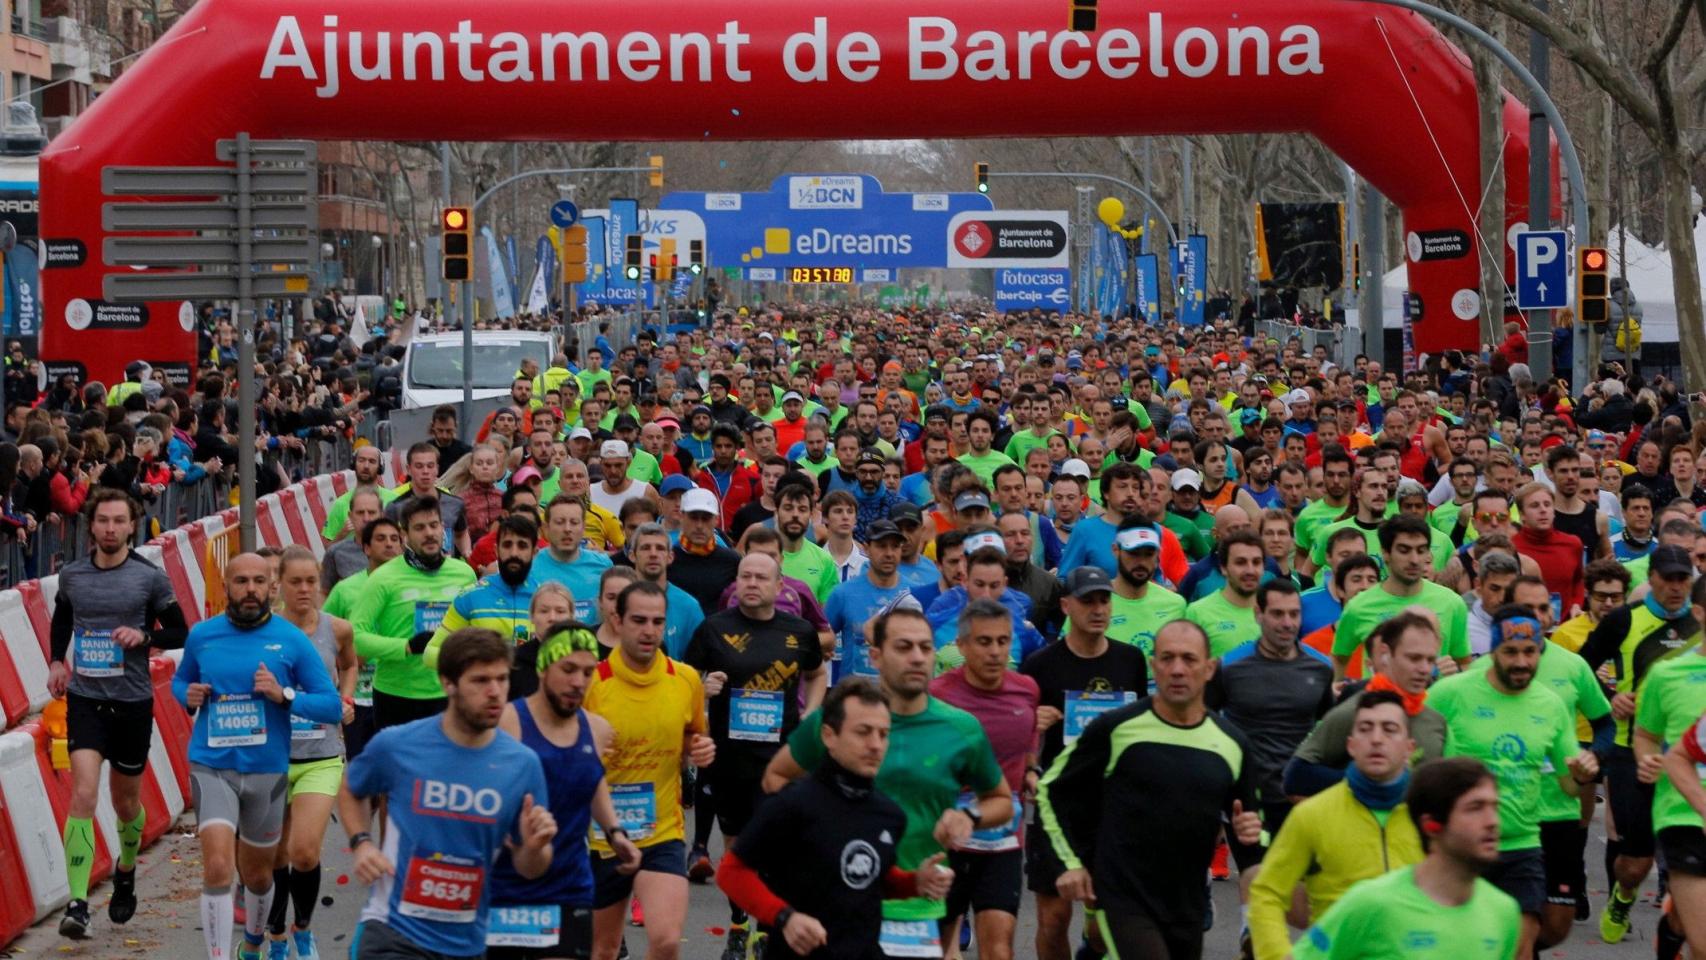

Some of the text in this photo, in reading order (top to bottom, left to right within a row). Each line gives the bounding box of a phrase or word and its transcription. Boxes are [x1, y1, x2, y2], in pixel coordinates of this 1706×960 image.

[259, 12, 1324, 98] Ajuntament de Barcelona
[821, 177, 855, 186] eDreams
[999, 229, 1053, 238] Ajuntament de
[796, 228, 912, 254] eDreams
[999, 238, 1053, 248] Barcelona
[1424, 243, 1462, 253] Barcelona
[1526, 237, 1558, 278] P
[1003, 270, 1064, 285] fotocasa
[97, 305, 129, 313] Ajuntament
[97, 312, 140, 322] Barcelona
[82, 650, 114, 662] 2092
[216, 703, 258, 715] MIGUEL
[218, 715, 259, 729] 14069
[740, 712, 775, 726] 1686
[423, 780, 502, 816] BDO
[420, 879, 472, 902] 9634
[498, 909, 551, 926] 13216
